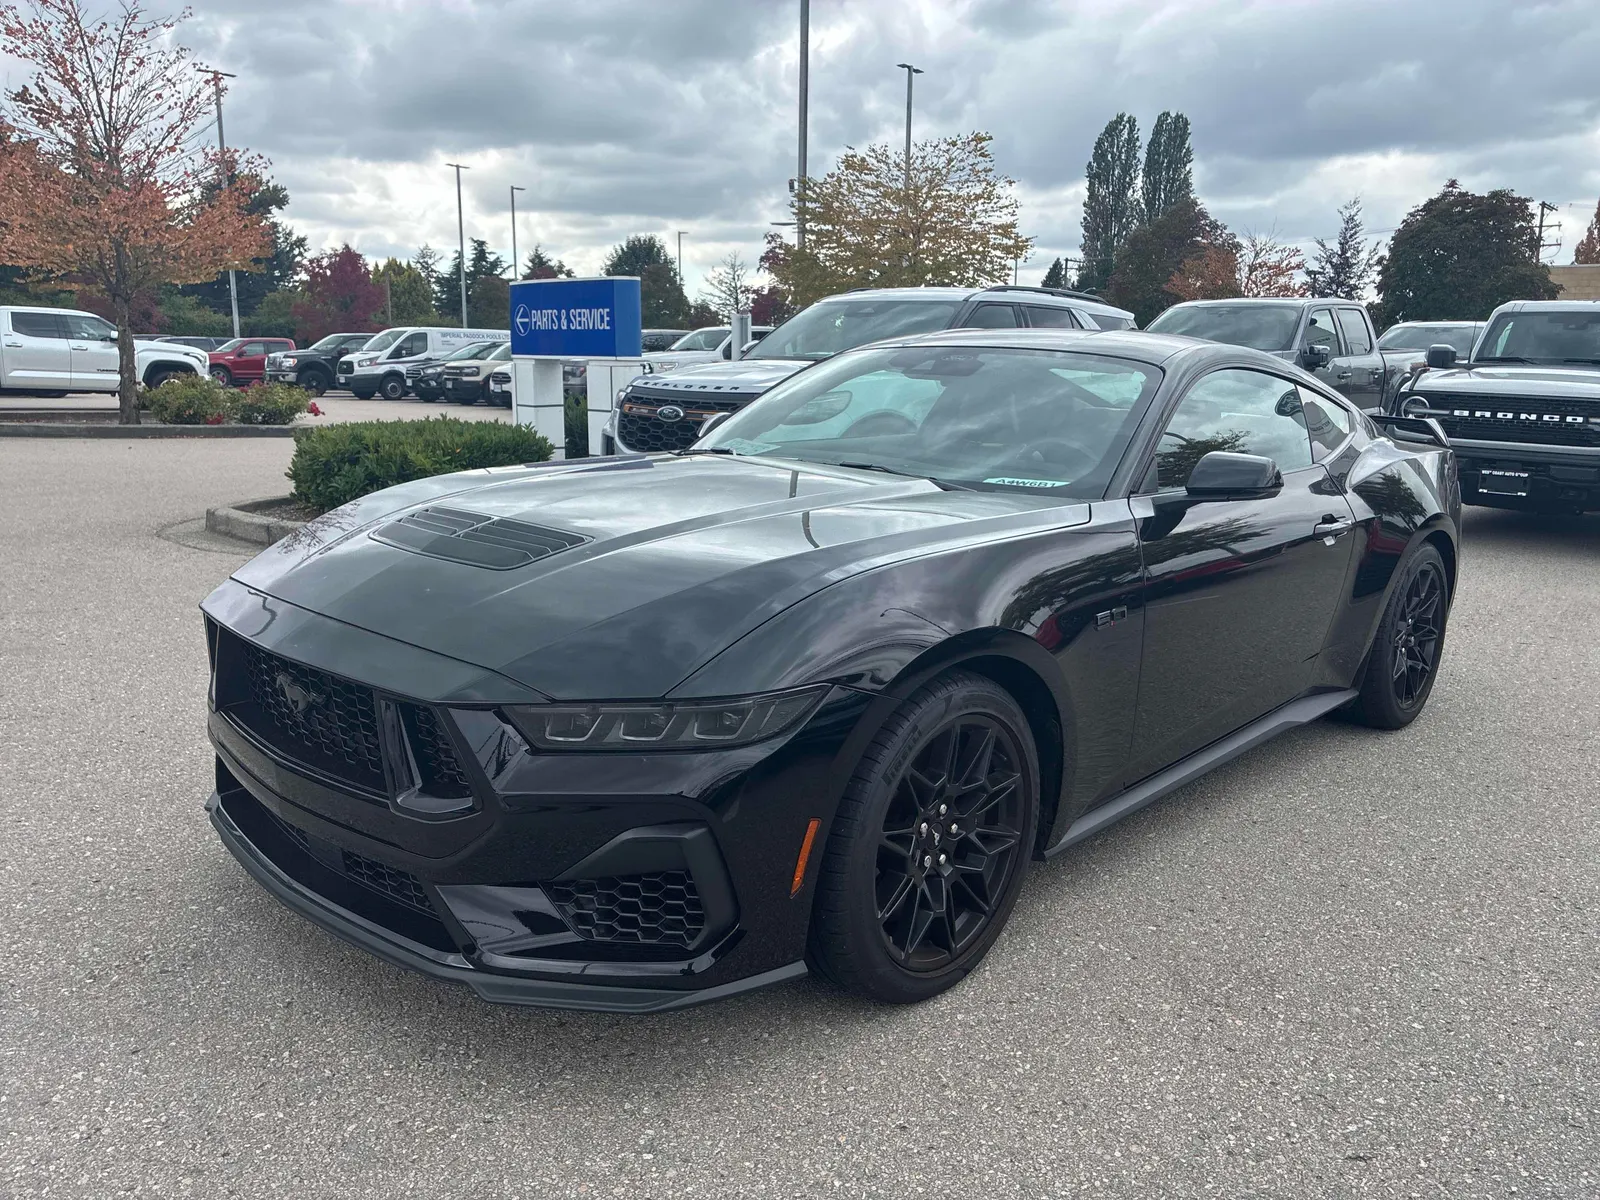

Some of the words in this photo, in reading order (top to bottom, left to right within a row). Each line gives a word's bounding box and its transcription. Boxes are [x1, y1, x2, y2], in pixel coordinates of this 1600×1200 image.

[531, 309, 558, 330] PARTS
[560, 309, 567, 330] &
[570, 308, 611, 330] SERVICE
[642, 381, 740, 391] EXPLORER
[1453, 409, 1584, 423] BRONCO
